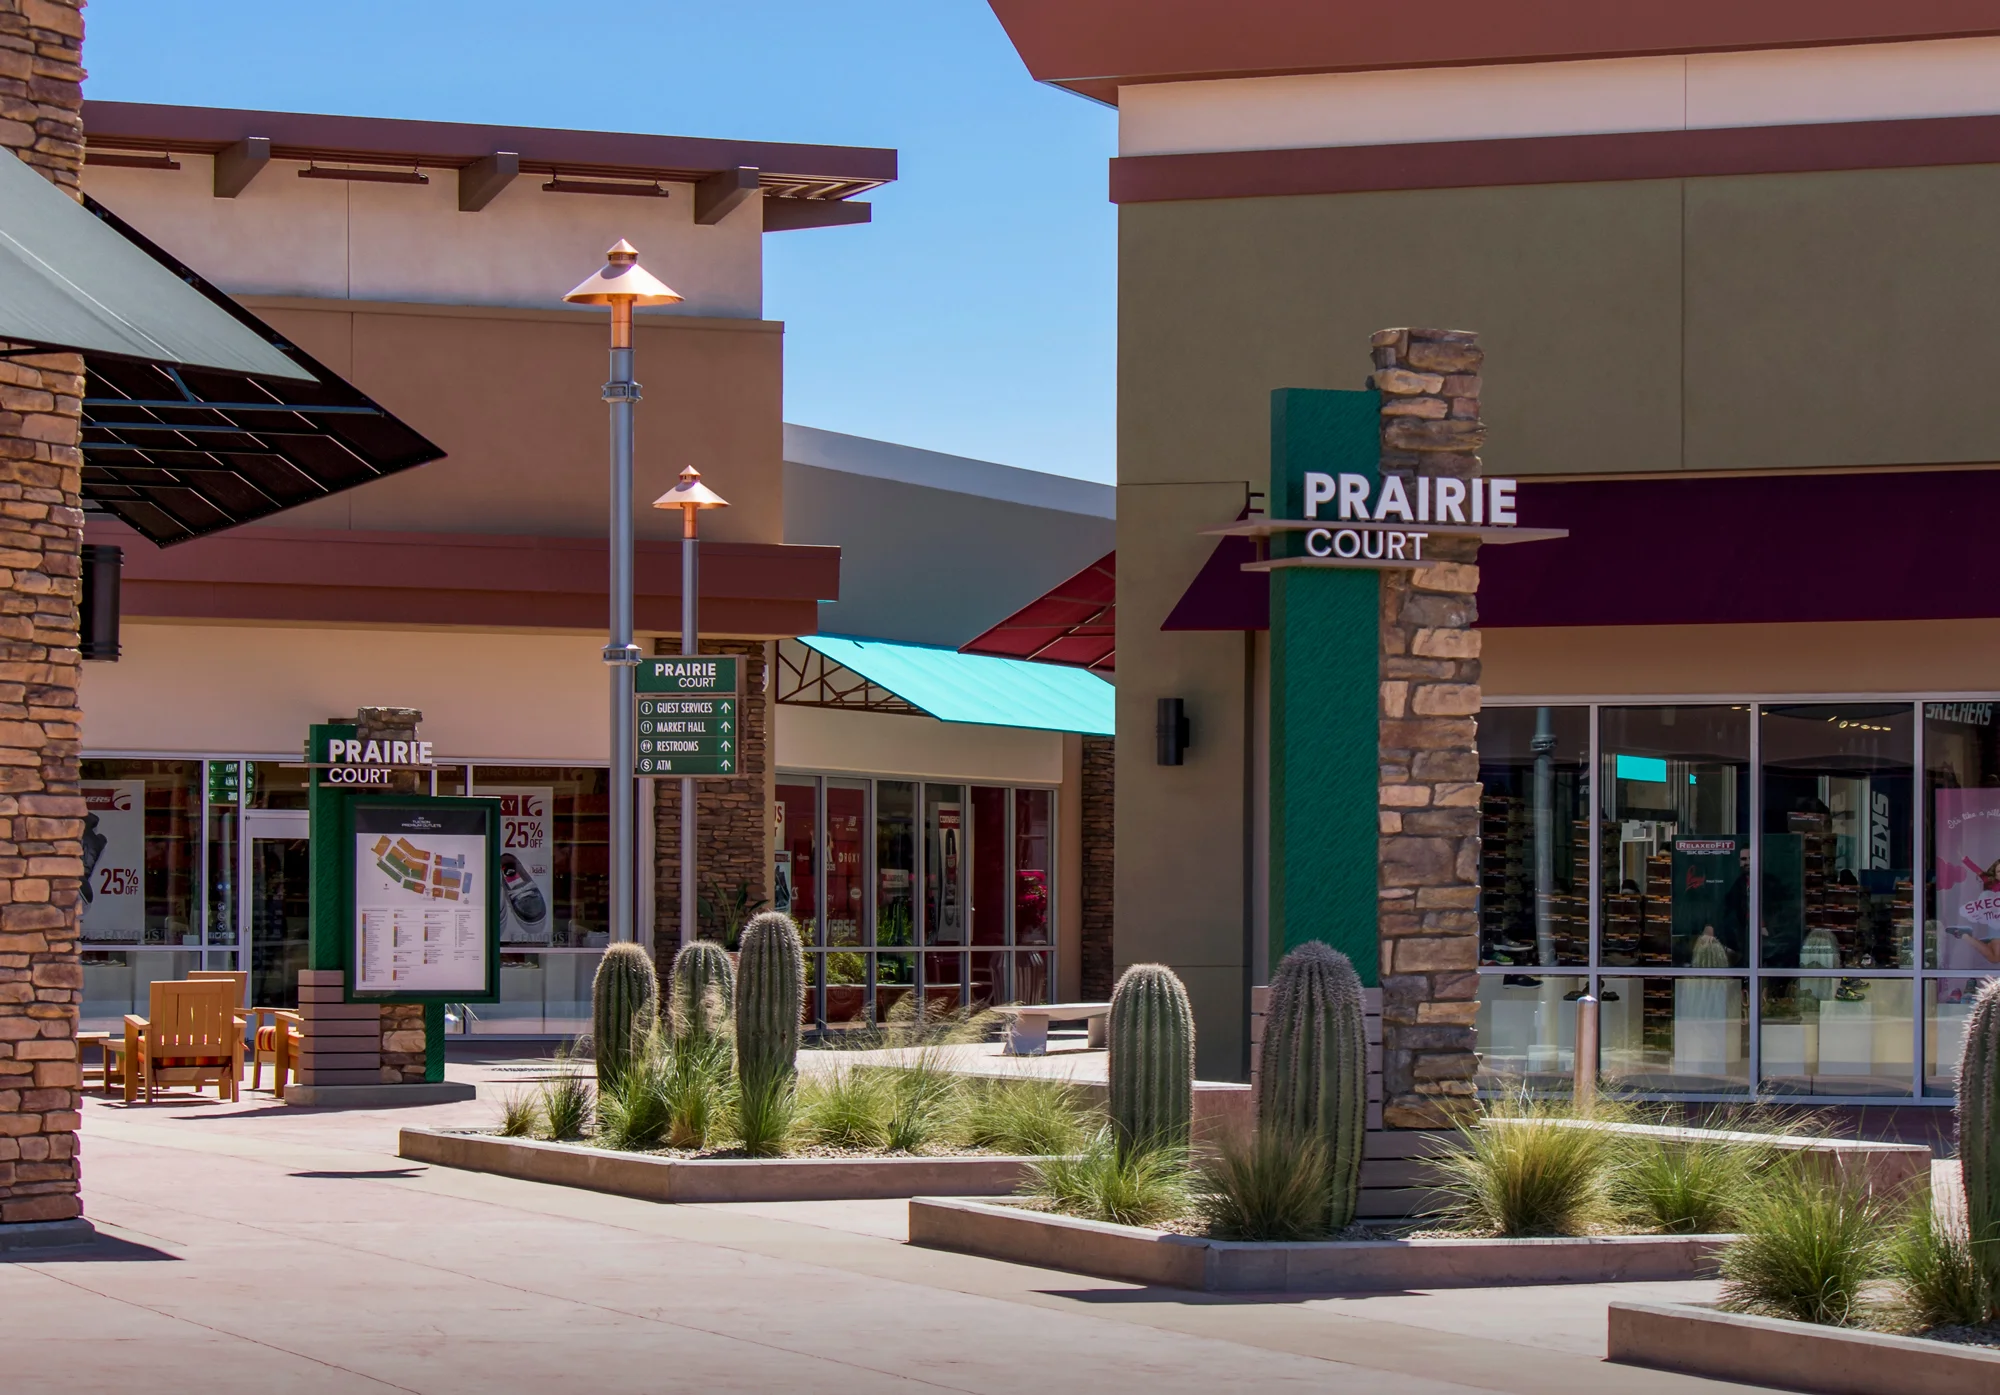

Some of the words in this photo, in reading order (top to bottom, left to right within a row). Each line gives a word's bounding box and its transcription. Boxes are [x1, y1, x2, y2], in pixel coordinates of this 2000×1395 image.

[1304, 471, 1518, 526] PRAIRIE
[1305, 528, 1429, 561] COURT
[655, 663, 717, 676] PRAIRIE
[679, 677, 716, 688] COURT
[656, 702, 680, 713] GUEST
[681, 702, 713, 713] SERVICES
[1925, 702, 1993, 726] SKECHERS
[656, 721, 686, 733] MARKET
[687, 722, 706, 733] HALL
[328, 739, 433, 764] PRAIRIE
[656, 741, 699, 752] RESTROOMS
[656, 760, 672, 771] ATM
[328, 767, 392, 784] COURT
[505, 821, 543, 848] 25%
[529, 839, 543, 848] OFF
[100, 868, 138, 895] 25%
[125, 886, 138, 895] OFF
